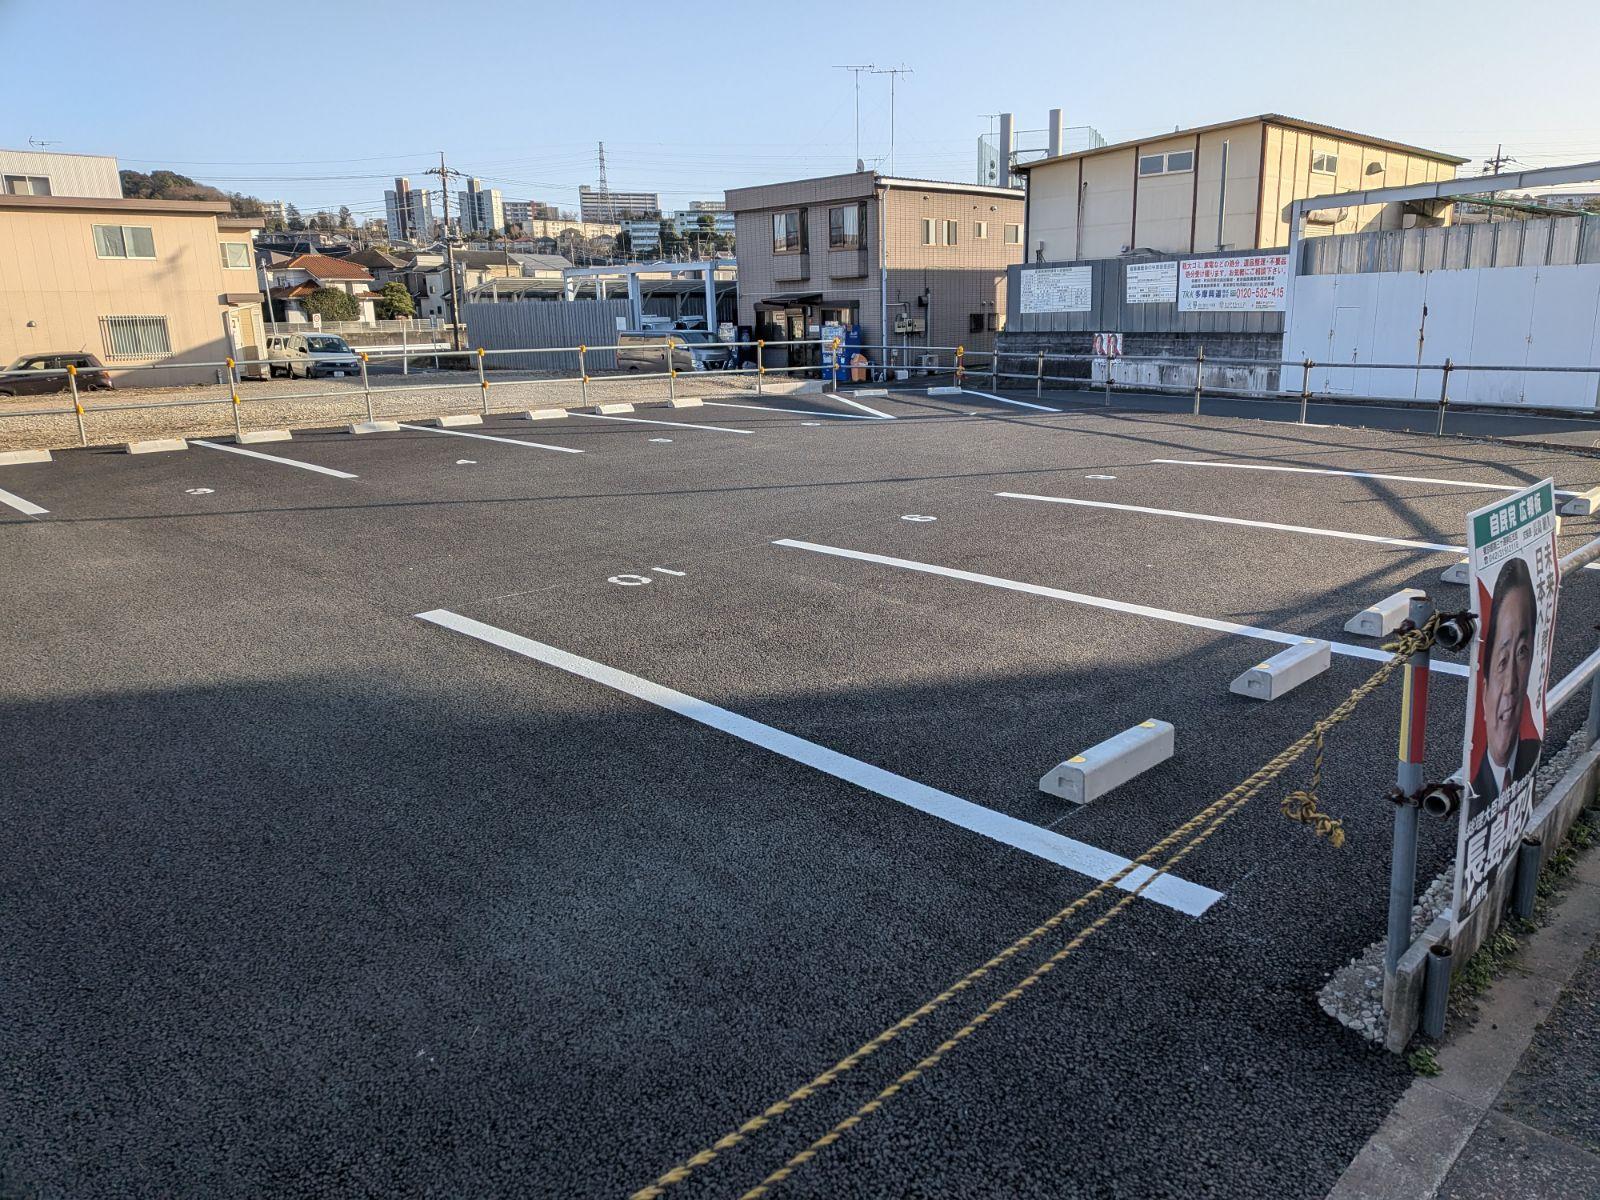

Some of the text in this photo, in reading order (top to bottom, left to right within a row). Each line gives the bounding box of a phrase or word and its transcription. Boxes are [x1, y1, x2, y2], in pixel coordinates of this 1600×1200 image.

[1236, 287, 1284, 298] 0120-532-415
[1489, 492, 1542, 538] 自民党 広報板
[1535, 542, 1555, 709] 未来に誇れる
[1464, 777, 1534, 901] 長島昭久
